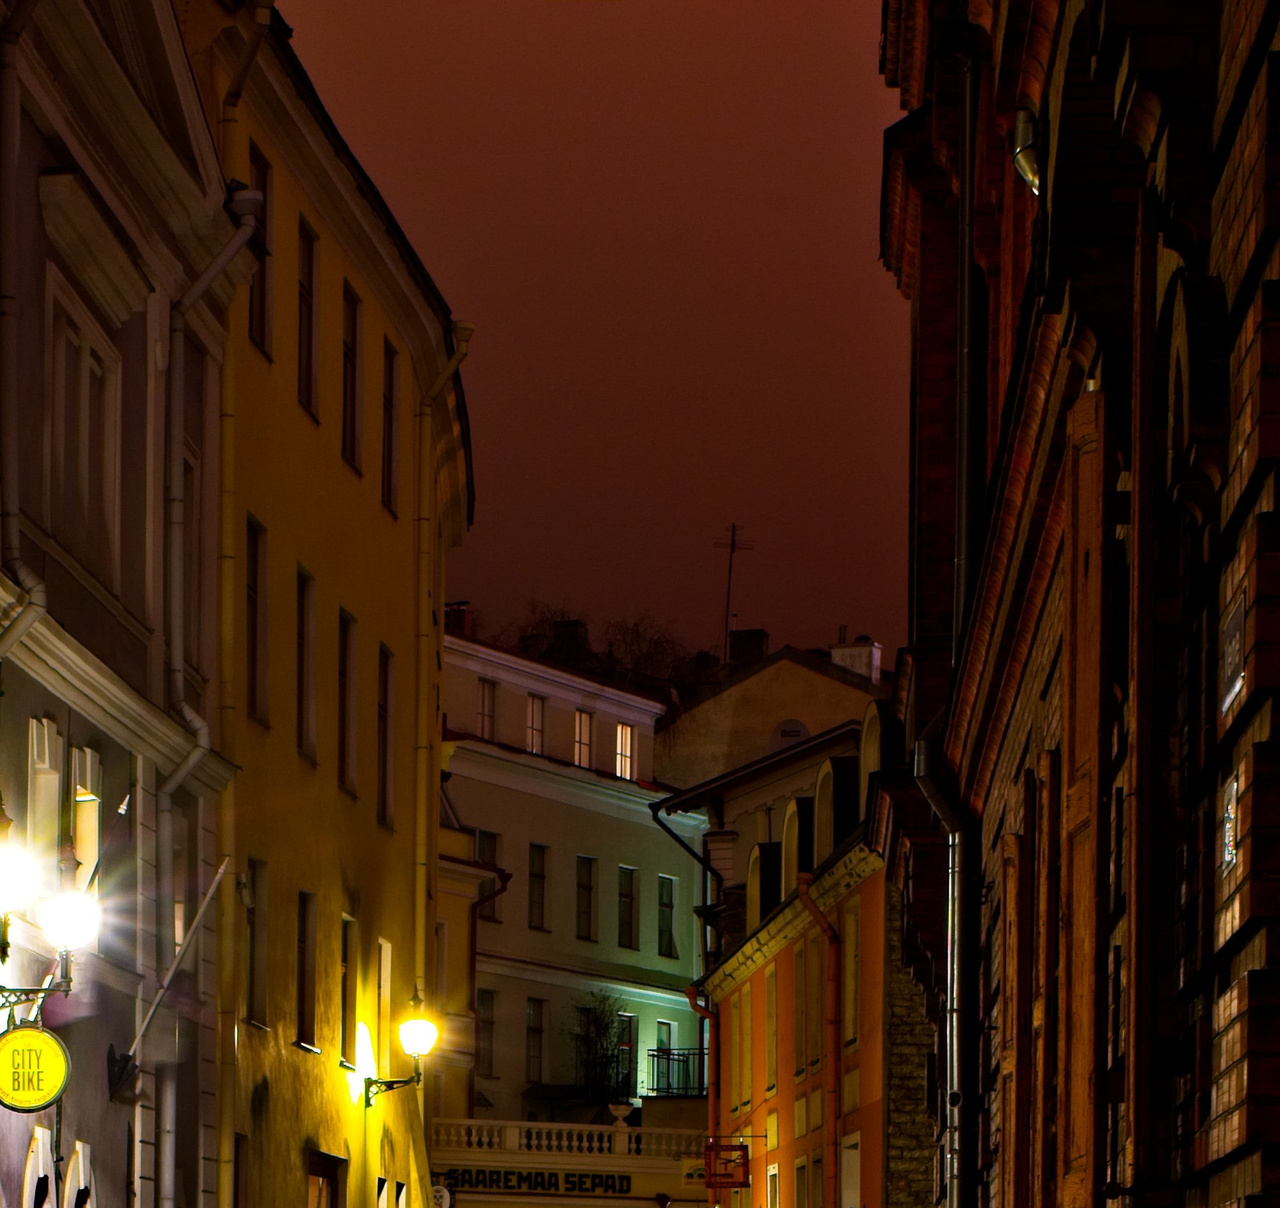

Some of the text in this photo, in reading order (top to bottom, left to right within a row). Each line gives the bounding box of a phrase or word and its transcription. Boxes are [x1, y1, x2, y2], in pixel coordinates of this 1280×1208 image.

[12, 1048, 43, 1070] CITY
[12, 1070, 44, 1092] BIKE
[447, 1169, 631, 1194] SAAREMAA SEPAD
